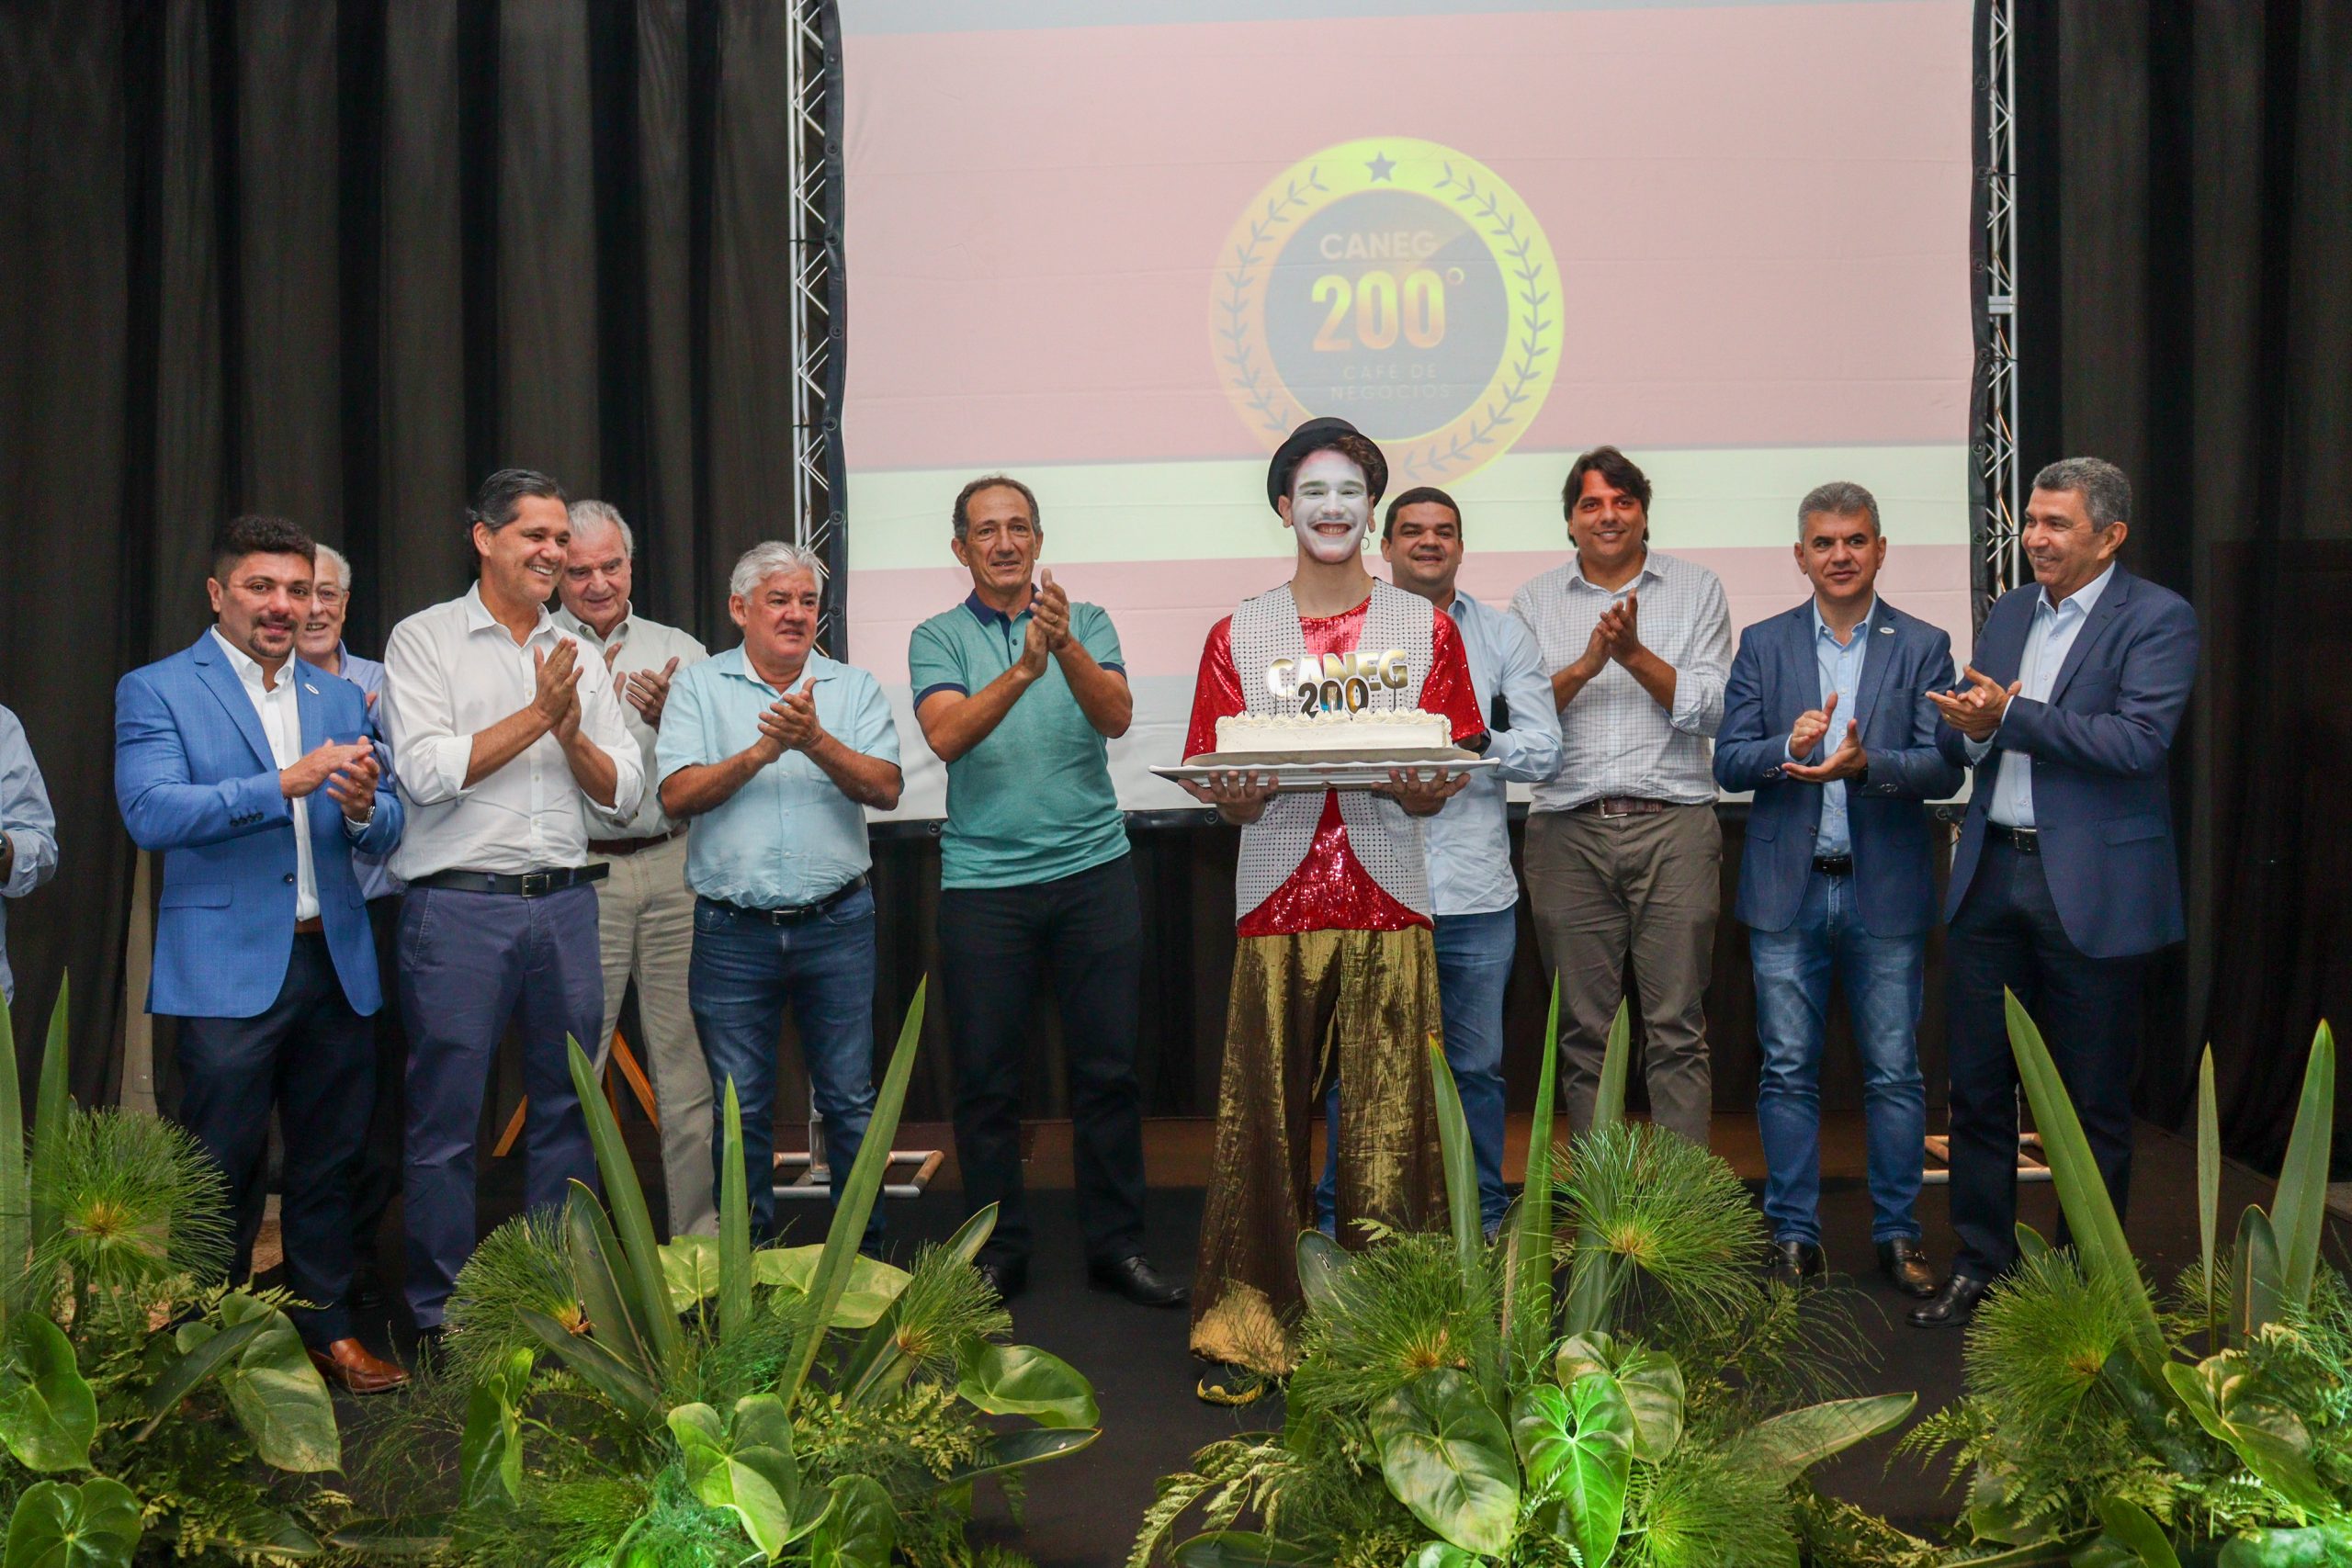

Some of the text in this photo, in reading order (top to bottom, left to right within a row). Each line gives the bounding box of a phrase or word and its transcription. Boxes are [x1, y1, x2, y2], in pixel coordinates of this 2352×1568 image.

[1320, 231, 1436, 260] CANEG
[1410, 363, 1438, 379] DE
[1329, 383, 1450, 401] NEGOCIOS
[1267, 649, 1408, 697] CANEG
[1297, 676, 1369, 718] 200
